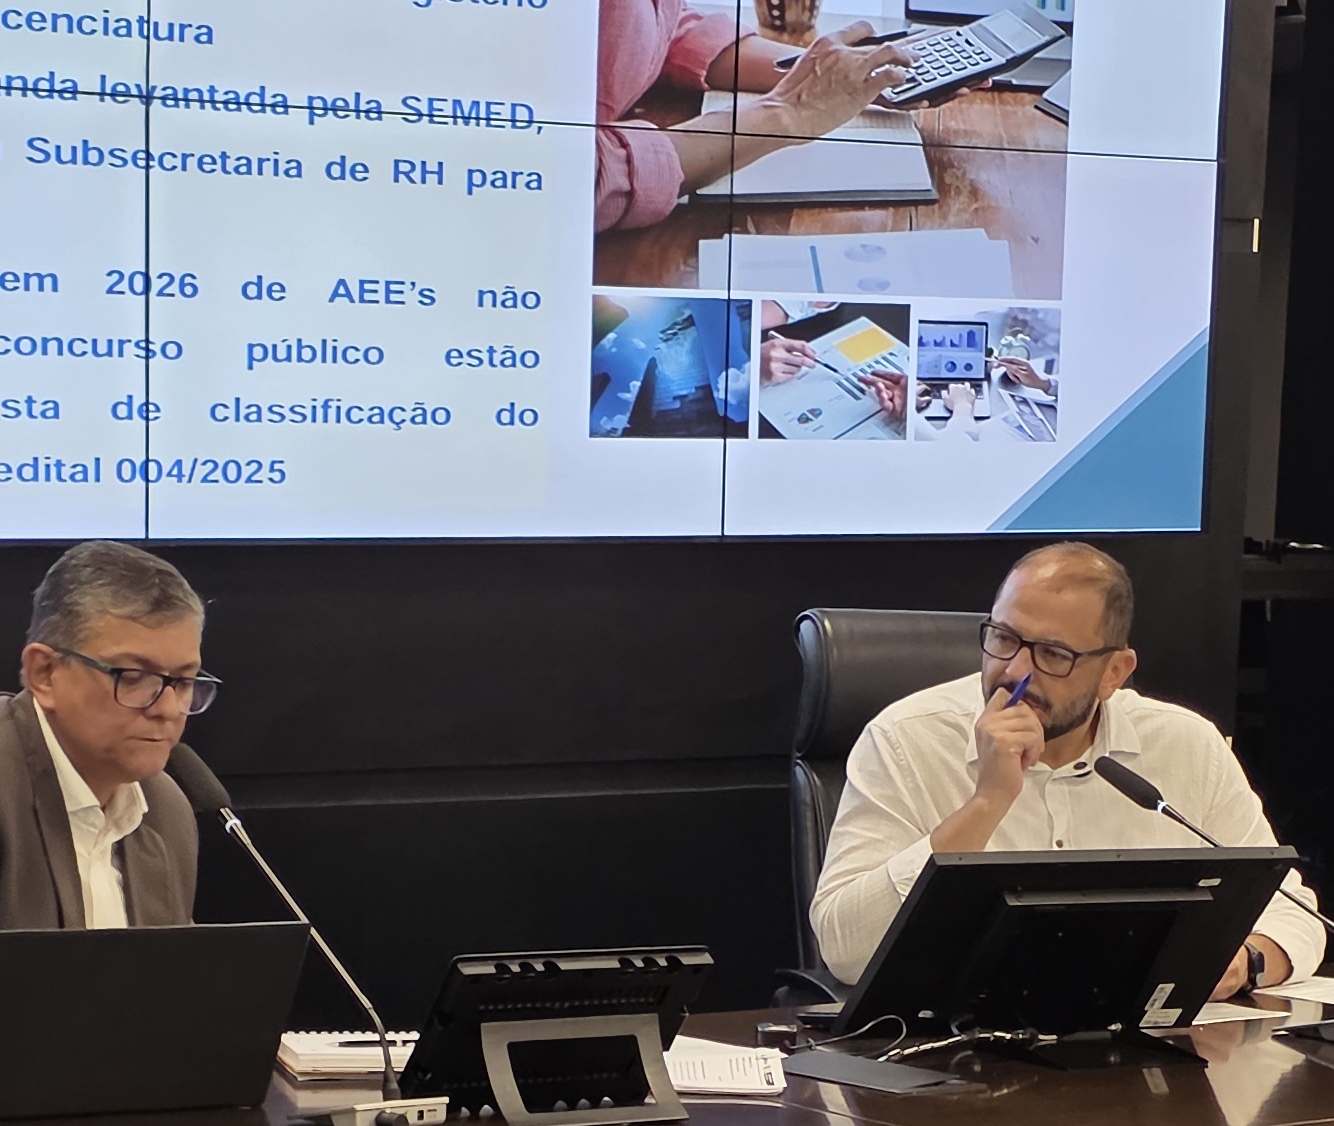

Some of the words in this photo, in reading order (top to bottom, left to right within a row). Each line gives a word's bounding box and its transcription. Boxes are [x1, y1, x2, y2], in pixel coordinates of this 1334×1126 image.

[98, 74, 290, 117] levantada
[306, 91, 383, 124] pela
[400, 95, 545, 135] SEMED,
[25, 136, 303, 178] Subsecretaria
[324, 154, 370, 182] de
[393, 158, 444, 186] RH
[466, 166, 543, 196] para
[105, 269, 199, 299] 2026
[241, 274, 287, 302] de
[477, 285, 541, 310] não
[247, 337, 385, 371] público
[444, 342, 540, 369] estão
[110, 394, 161, 421] de
[209, 396, 452, 431] classificação
[495, 401, 539, 427] do
[116, 457, 286, 484] 004/2025
